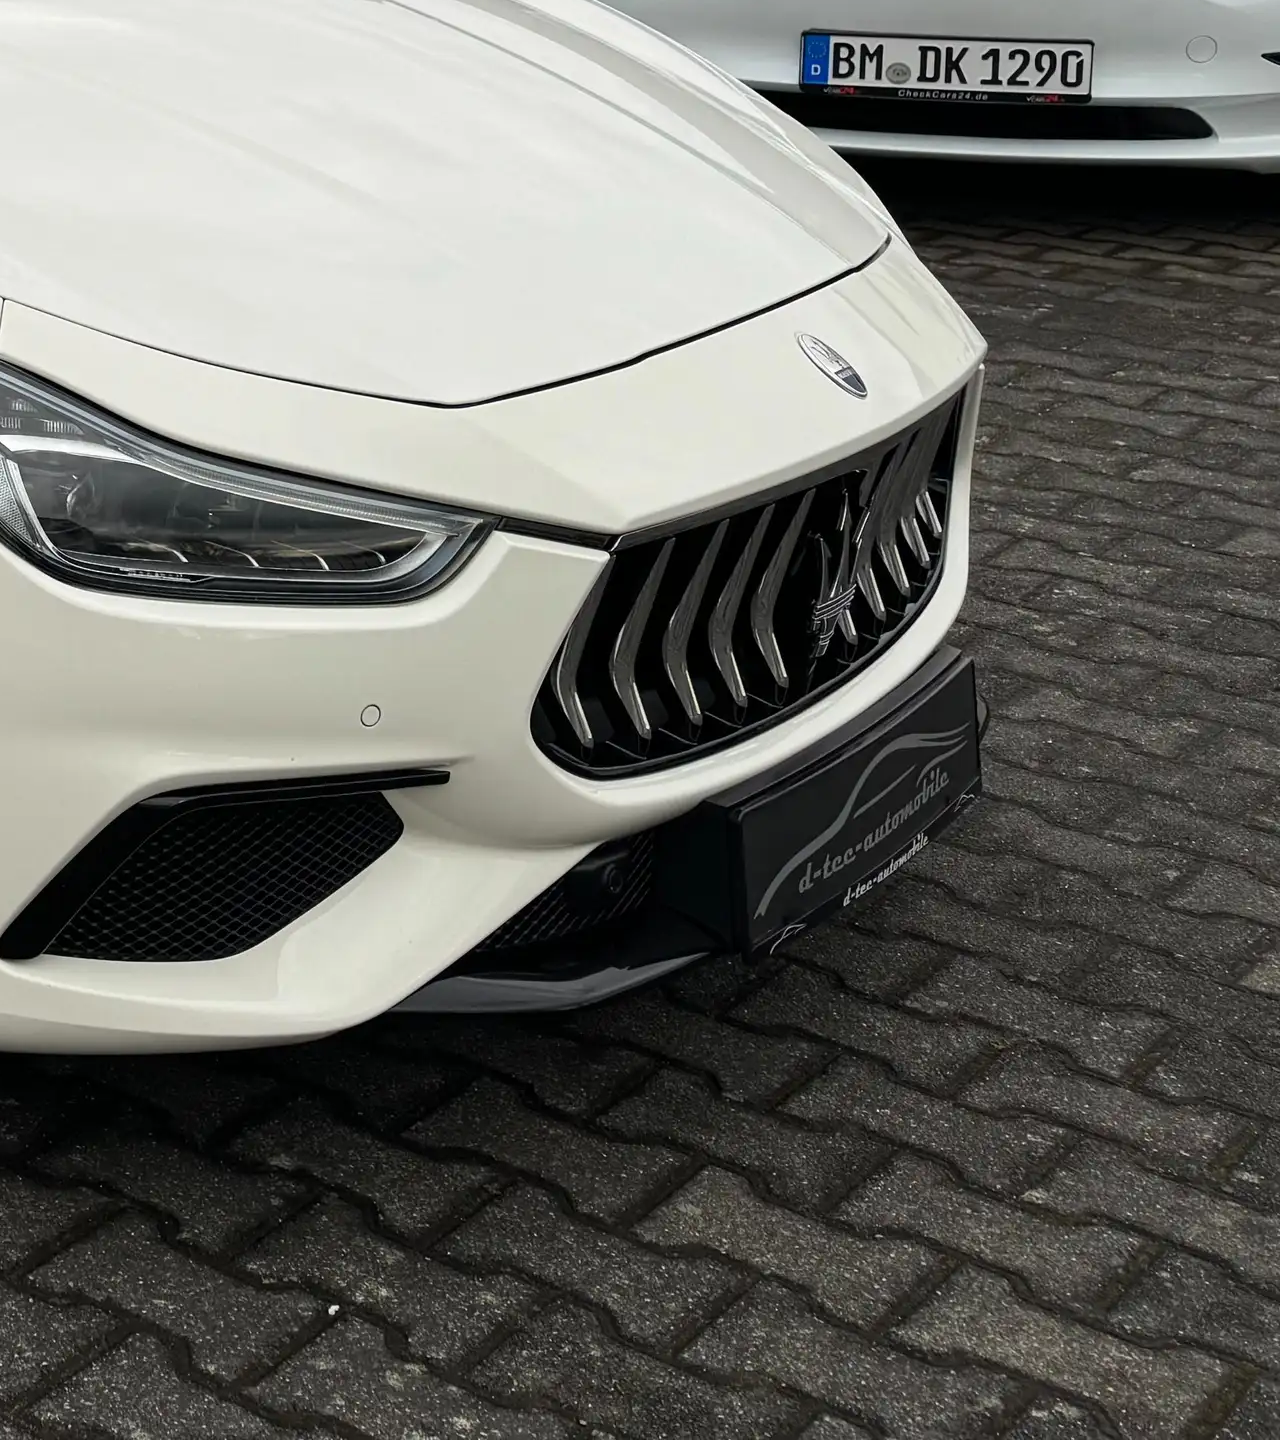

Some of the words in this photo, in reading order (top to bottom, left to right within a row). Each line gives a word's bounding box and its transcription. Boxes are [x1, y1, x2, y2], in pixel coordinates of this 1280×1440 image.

[810, 64, 821, 76] D
[831, 42, 884, 80] BM
[917, 45, 970, 84] DK
[980, 48, 1085, 88] 1290
[797, 766, 951, 895] d-tec-automobile
[842, 831, 930, 908] d-tec-automobile
